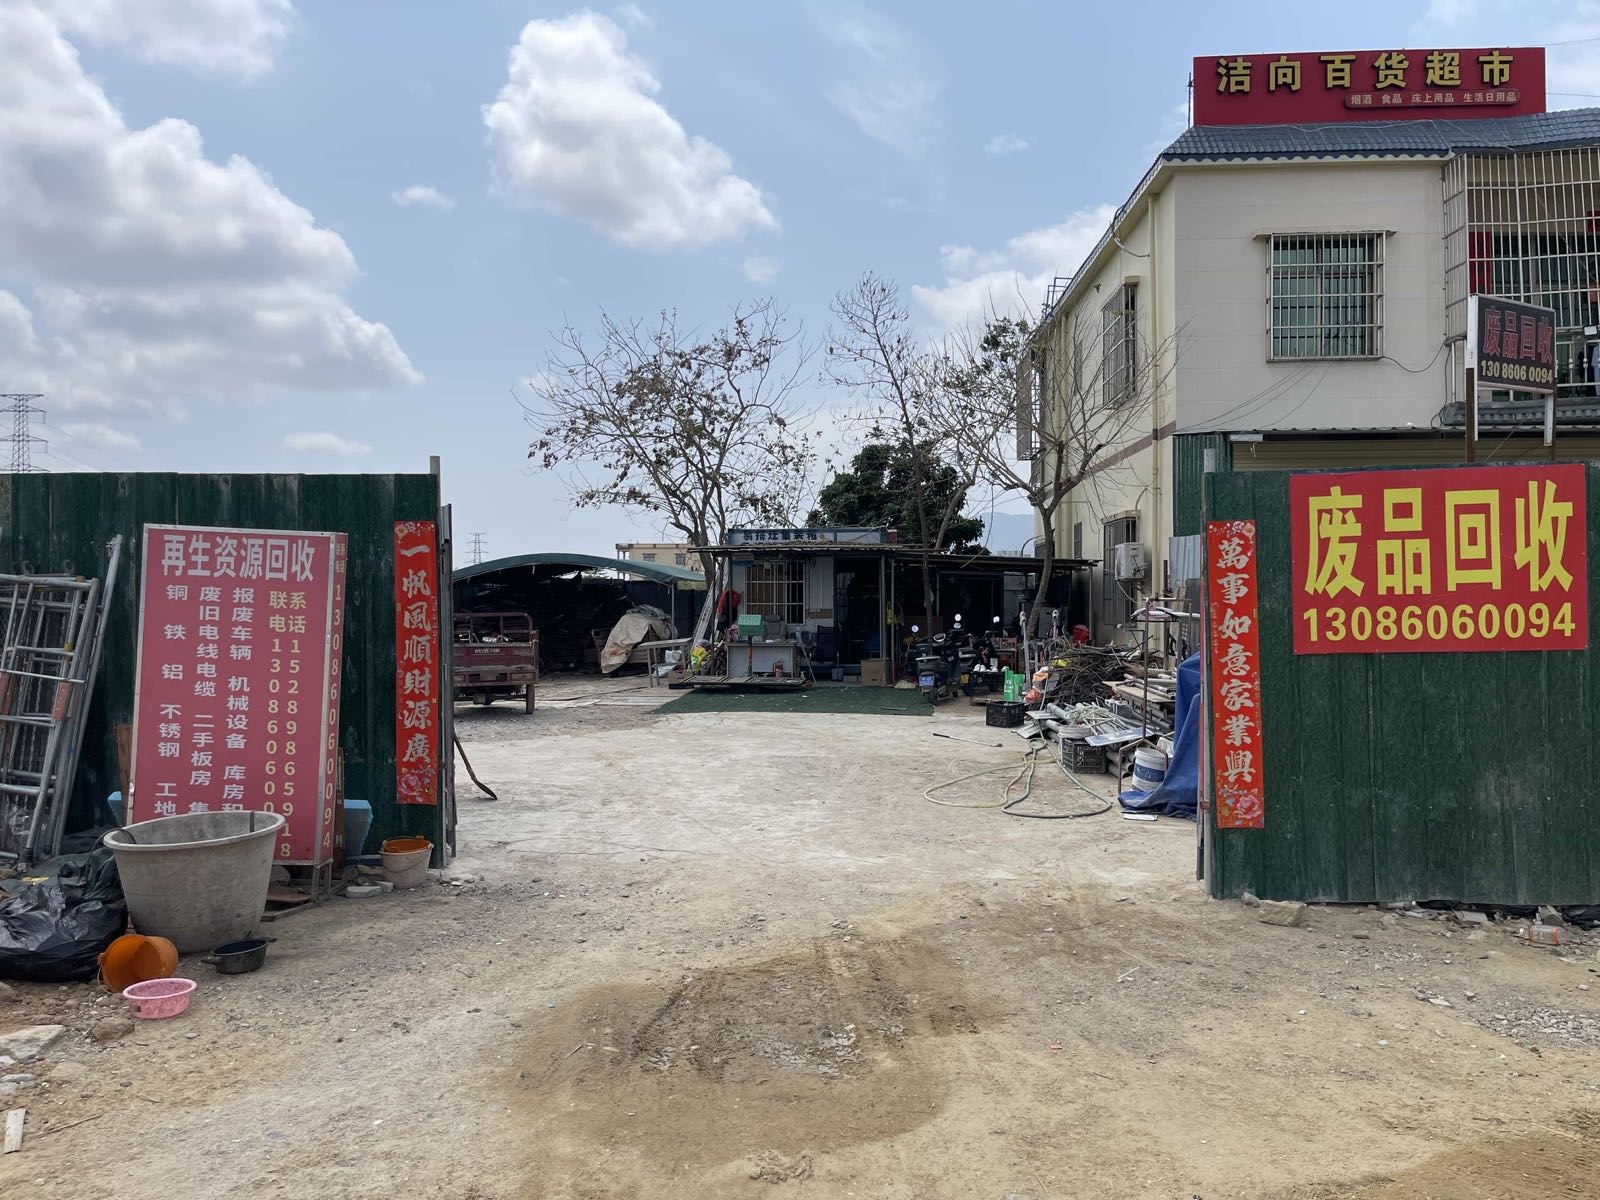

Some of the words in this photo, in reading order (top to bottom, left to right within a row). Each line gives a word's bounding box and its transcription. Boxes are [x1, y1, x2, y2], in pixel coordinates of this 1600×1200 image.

[1216, 50, 1514, 92] 洁向百货超市
[1351, 94, 1372, 105] 烟酒
[1381, 93, 1402, 104] 食品
[1411, 92, 1454, 104] 床上用品
[1463, 91, 1517, 103] 生活日用品
[1483, 306, 1553, 364] 废品回收
[1481, 360, 1500, 378] 130
[1502, 363, 1527, 381] 8606
[1529, 367, 1553, 384] 0094
[161, 534, 315, 582] 再生资源回收
[1304, 479, 1574, 598] 废品回收
[166, 584, 188, 601] 铜
[269, 590, 307, 609] 联系
[164, 624, 186, 640] 铁
[194, 586, 223, 697] 废旧电线电缆
[229, 587, 254, 661] 报废车辆
[269, 614, 307, 634] 电话
[1303, 602, 1576, 642] 13086060094
[162, 663, 184, 680] 铝
[400, 545, 432, 763] 一帆風順財源廣
[1216, 537, 1256, 783] 萬事如意家業興
[158, 703, 182, 758] 不锈钢
[225, 676, 250, 749] 机械设备
[323, 585, 342, 848] 13086060094
[190, 714, 214, 786] 二手板房
[280, 639, 301, 857] 15289865918
[154, 782, 178, 816] 工地
